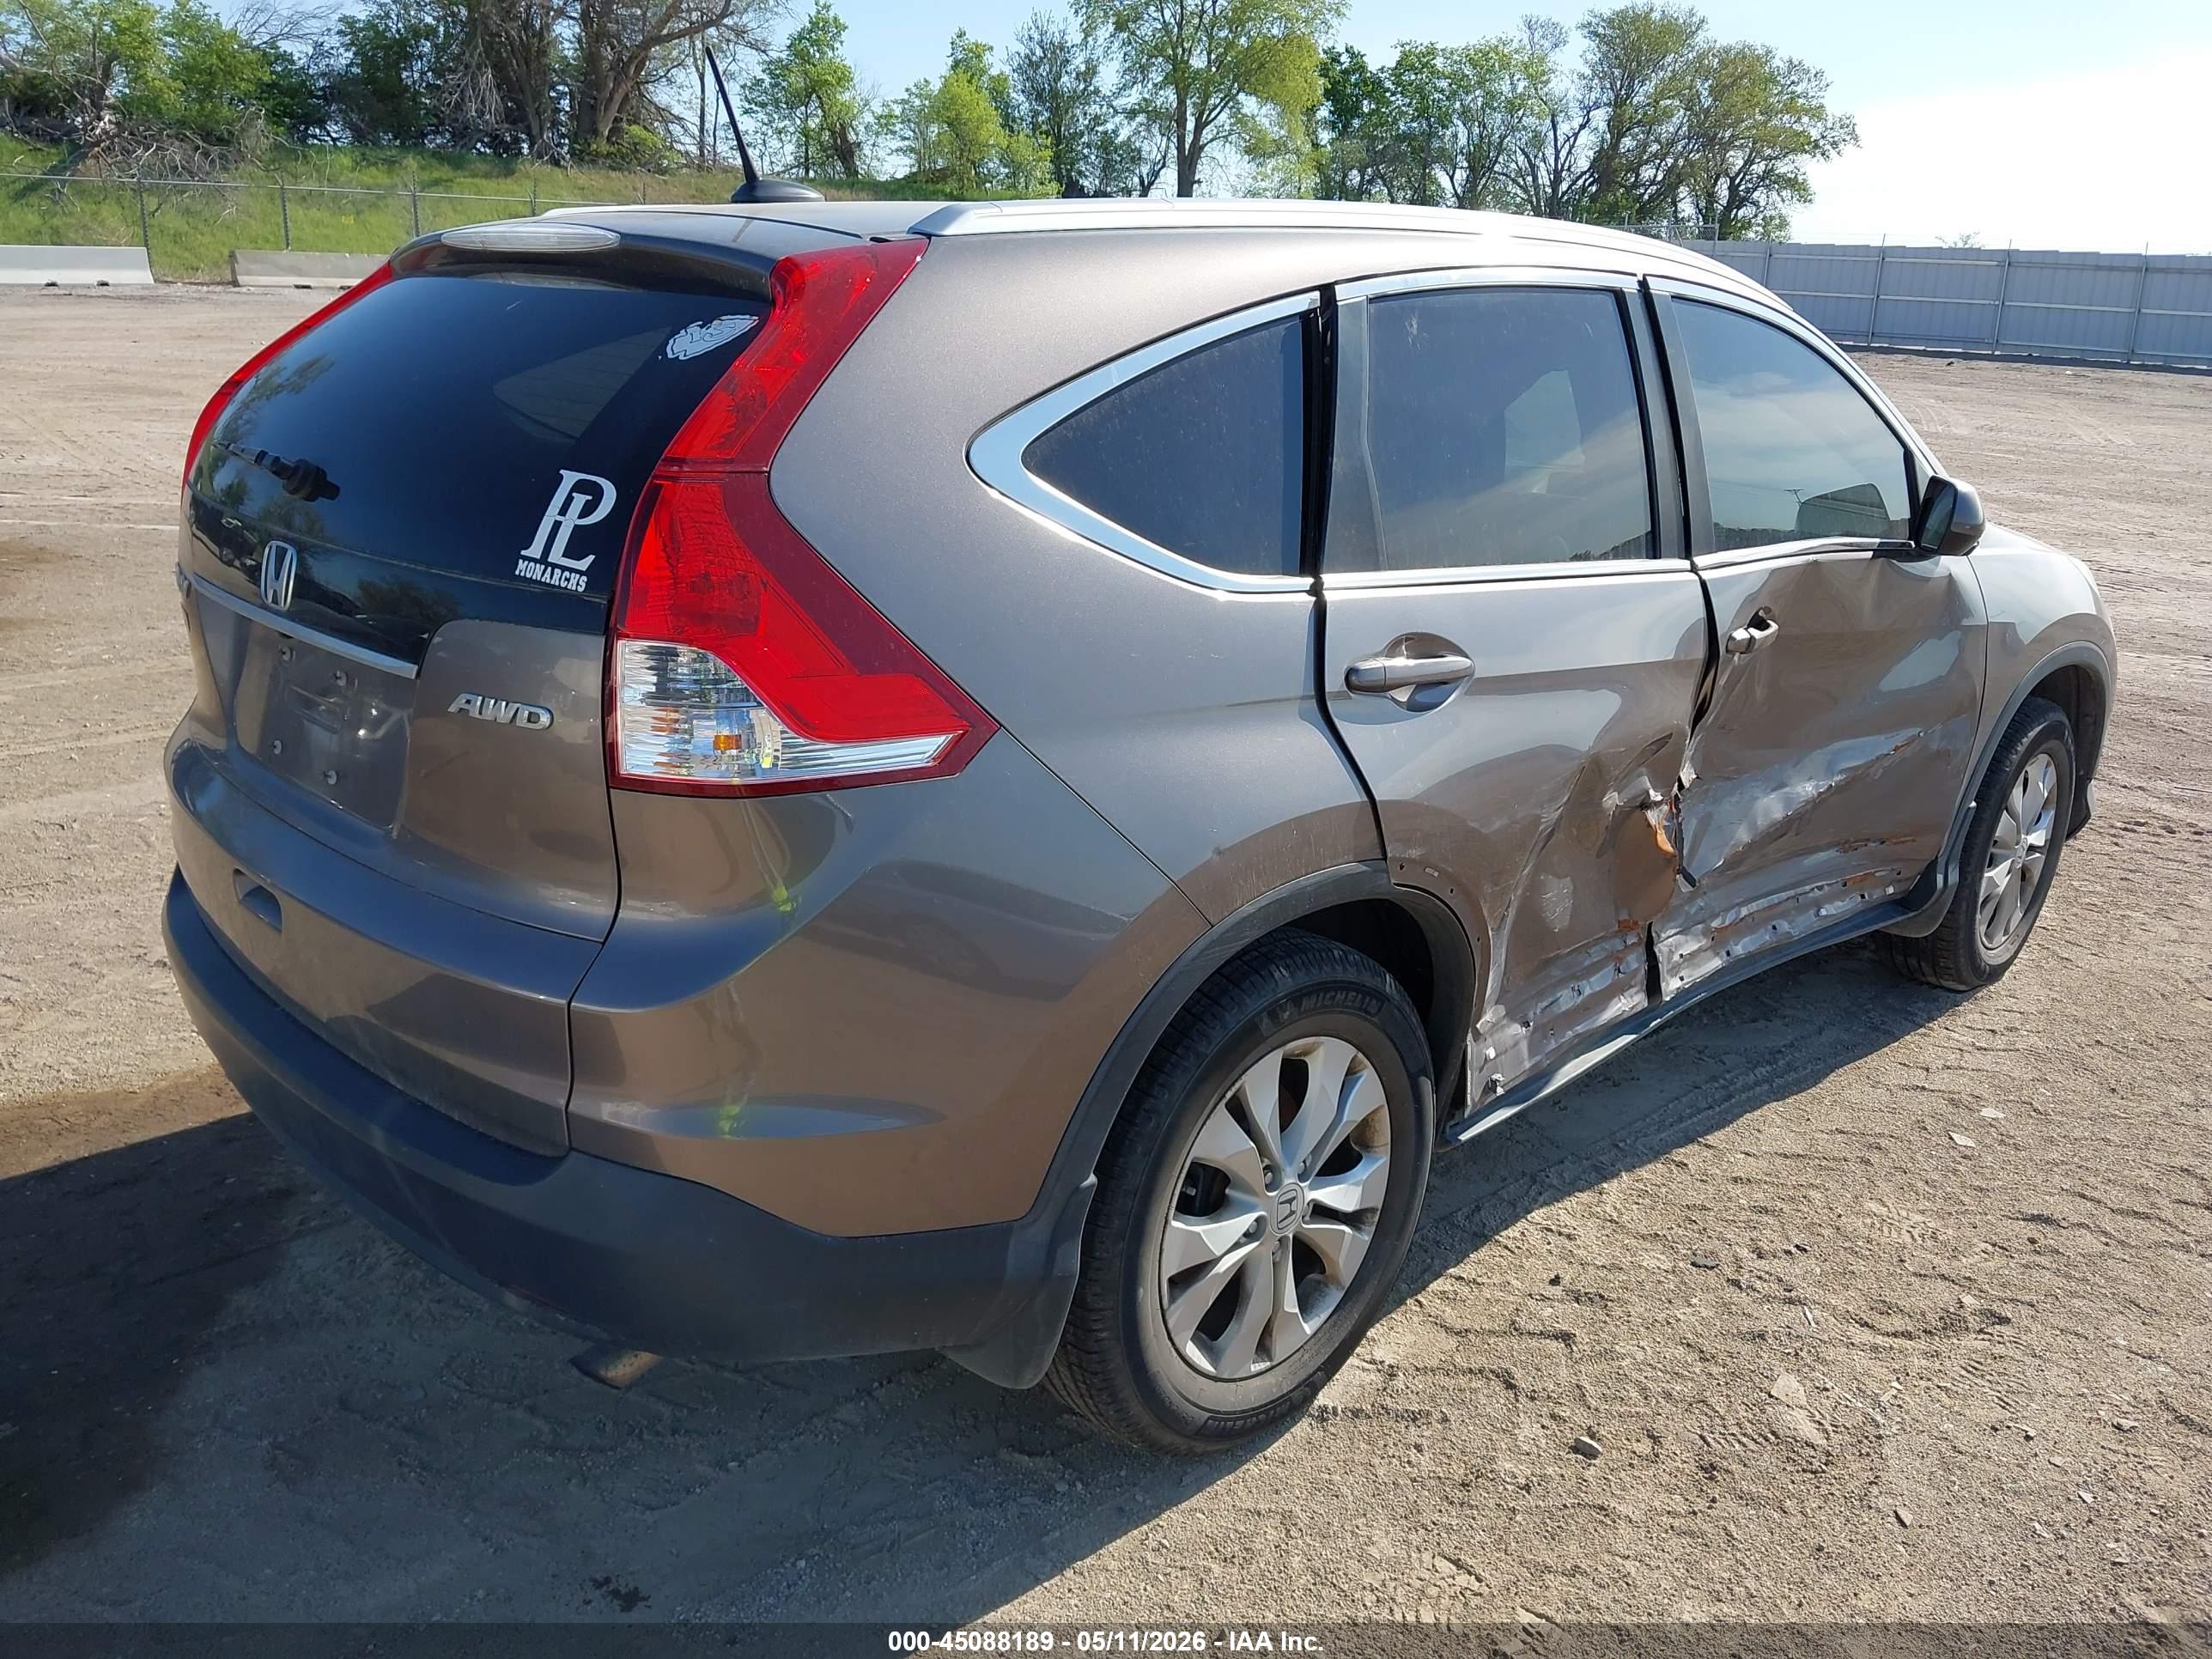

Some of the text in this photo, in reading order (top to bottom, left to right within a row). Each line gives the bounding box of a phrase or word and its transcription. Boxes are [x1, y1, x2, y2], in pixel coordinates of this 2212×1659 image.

[514, 558, 588, 592] MONARCHS
[447, 692, 555, 730] AWD
[1300, 989, 1383, 1018] MICHELIN
